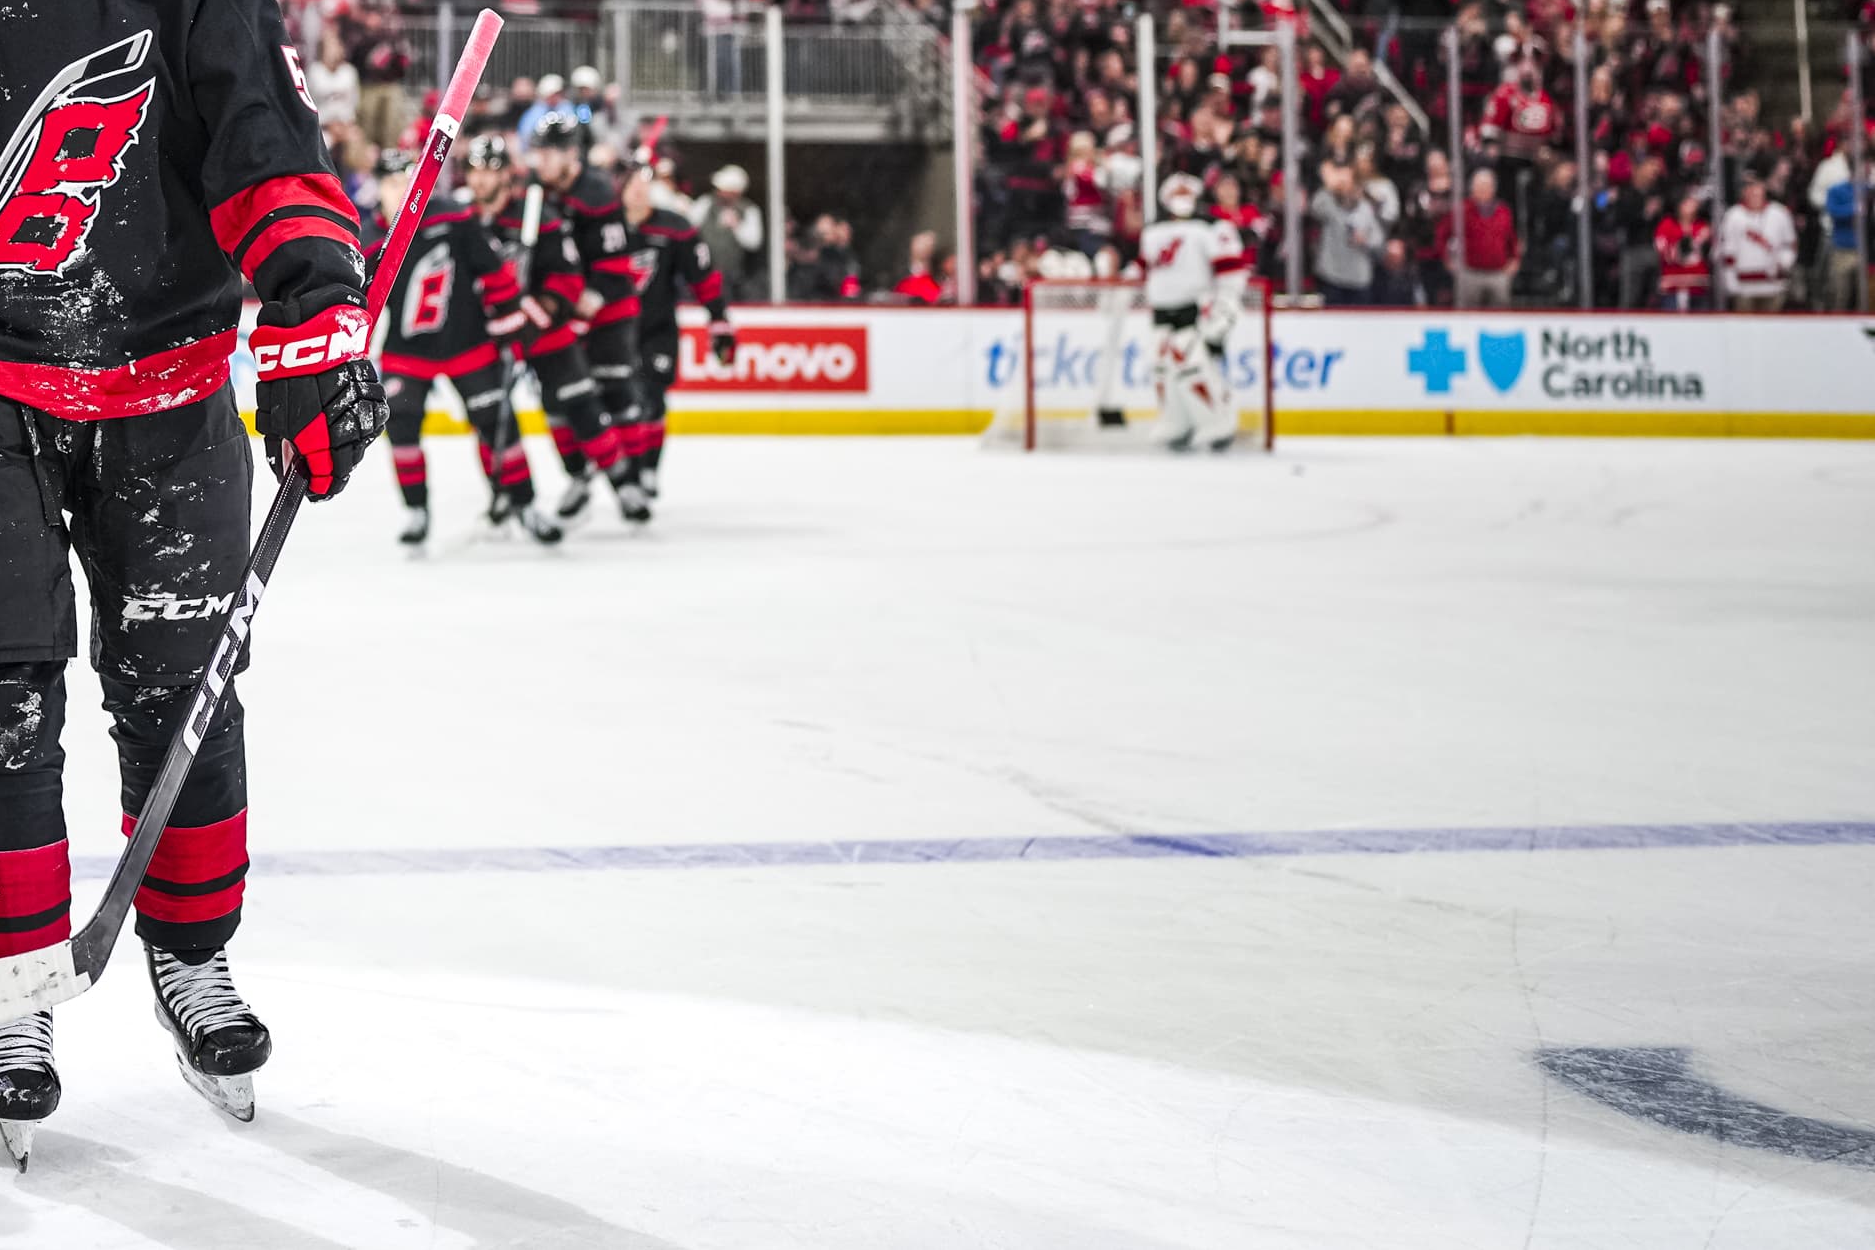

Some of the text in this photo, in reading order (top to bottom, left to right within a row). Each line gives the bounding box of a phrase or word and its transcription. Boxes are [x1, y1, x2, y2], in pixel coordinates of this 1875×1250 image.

[254, 324, 370, 372] CCM
[1541, 328, 1651, 361] North
[1541, 363, 1704, 401] Carolina
[122, 591, 237, 621] CCM
[182, 568, 266, 757] CCM
